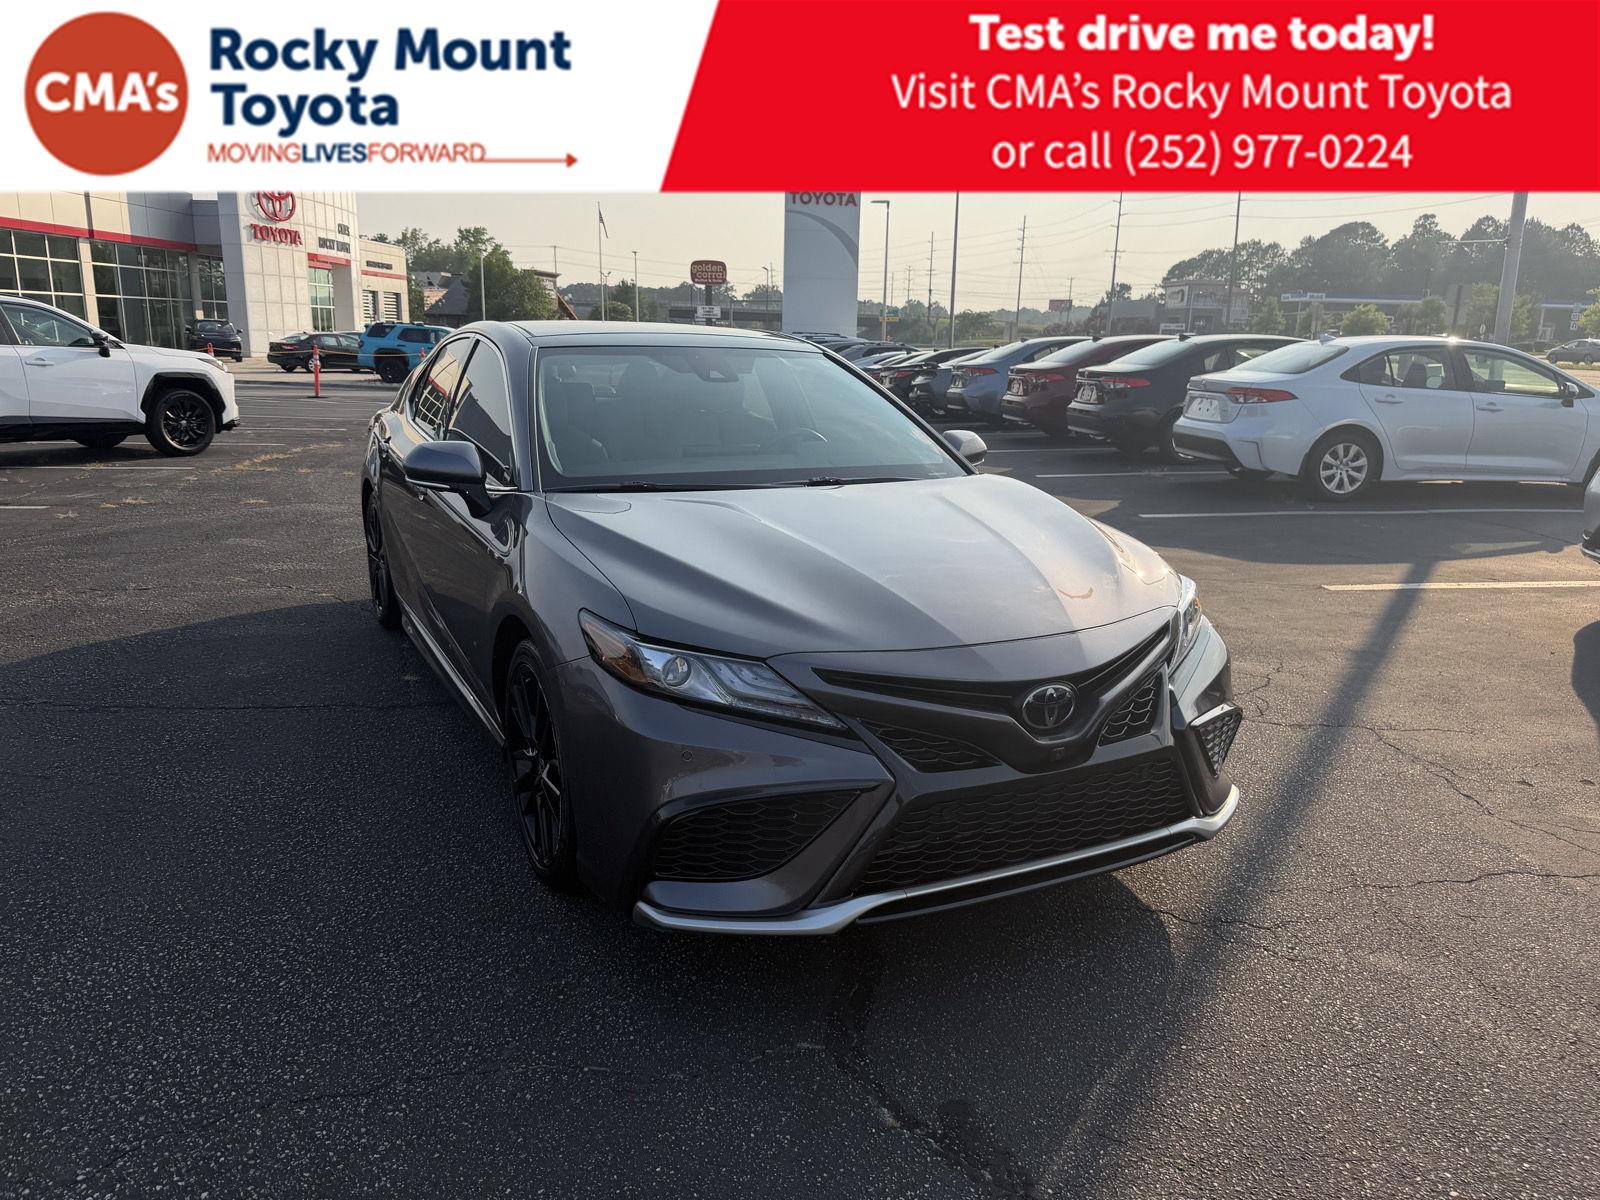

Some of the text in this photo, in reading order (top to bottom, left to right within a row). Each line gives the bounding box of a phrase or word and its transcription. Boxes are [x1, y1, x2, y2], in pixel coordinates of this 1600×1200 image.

[789, 191, 858, 207] TOYOTA
[250, 223, 303, 246] TOYOTA
[691, 263, 723, 274] golden
[696, 270, 726, 279] corral
